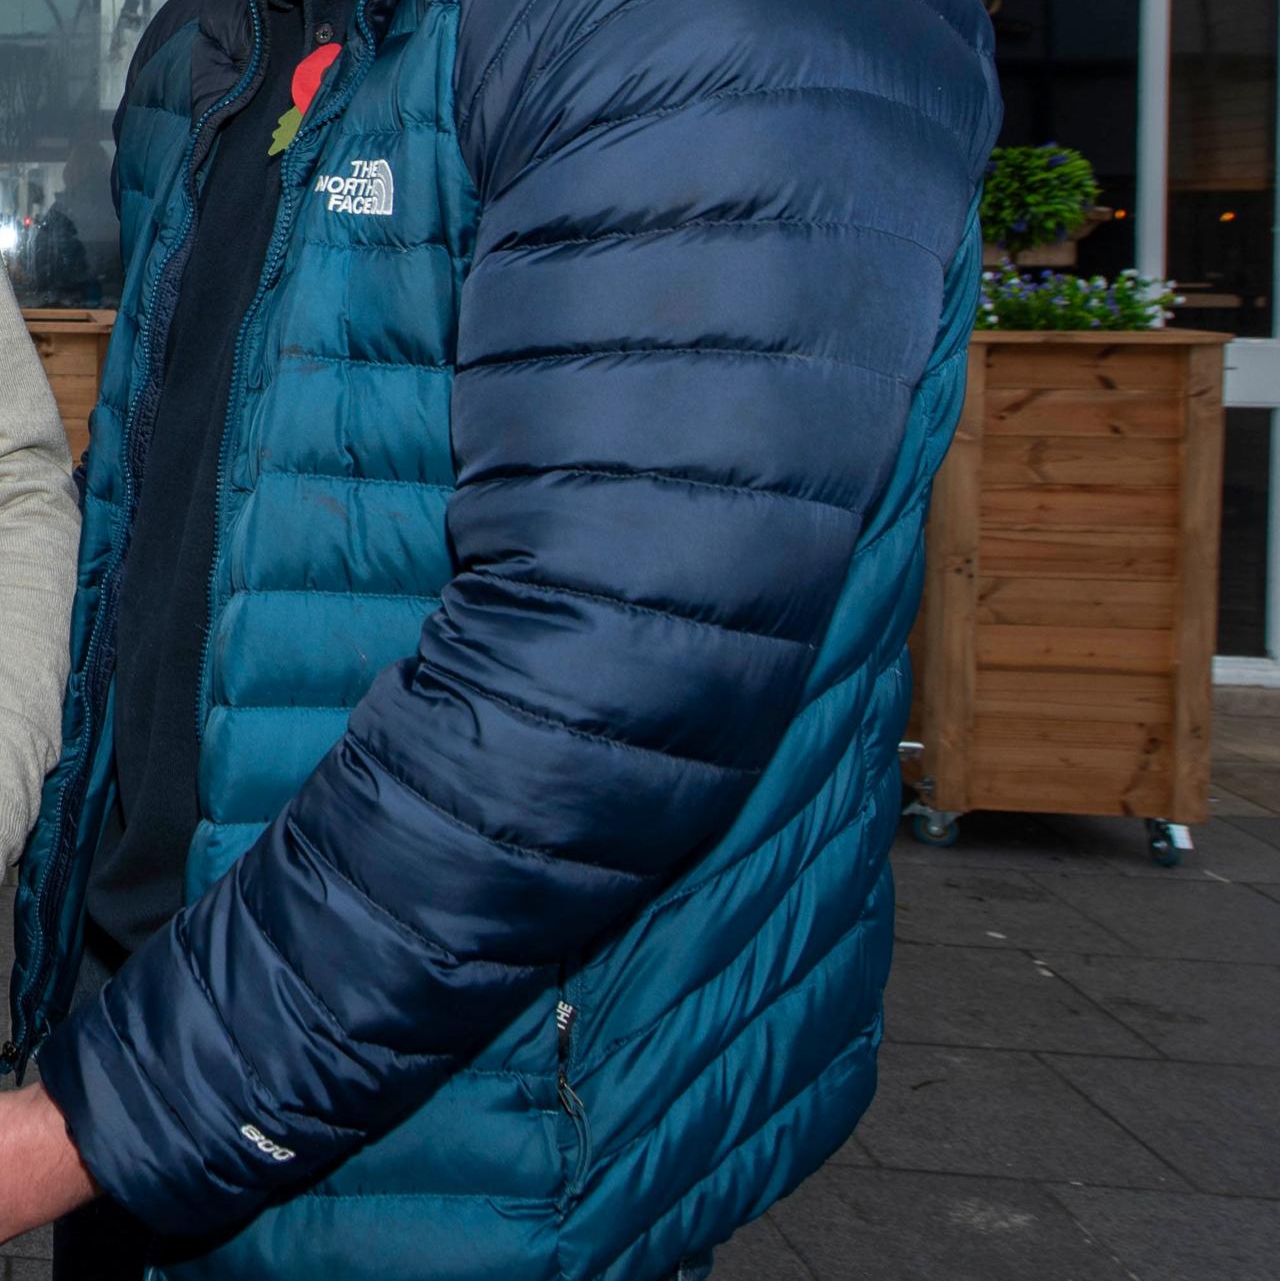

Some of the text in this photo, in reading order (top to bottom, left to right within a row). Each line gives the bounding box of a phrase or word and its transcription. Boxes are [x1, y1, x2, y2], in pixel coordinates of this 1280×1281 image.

[350, 160, 379, 179] THE
[314, 175, 376, 196] NORTH
[328, 193, 374, 215] FACE
